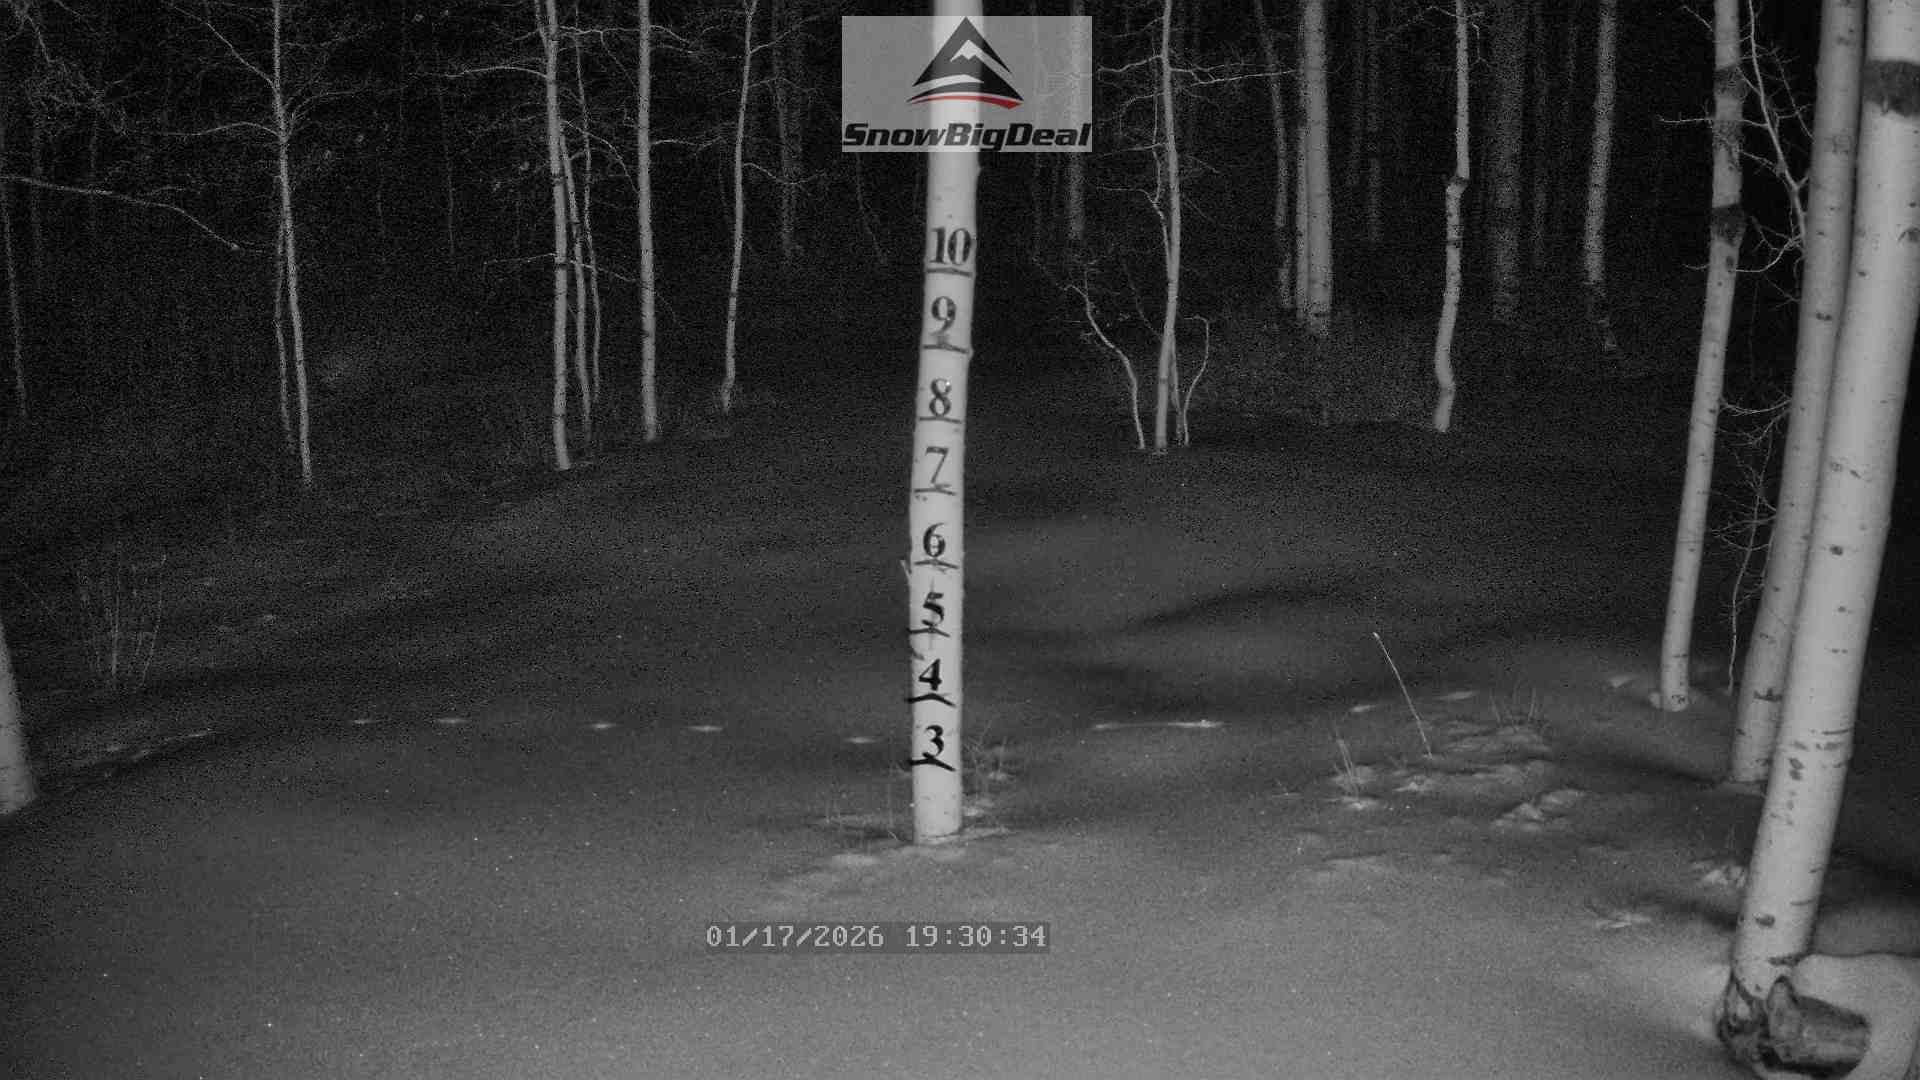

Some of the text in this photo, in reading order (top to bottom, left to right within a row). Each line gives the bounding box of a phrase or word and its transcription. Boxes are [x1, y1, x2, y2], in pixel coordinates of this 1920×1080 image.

[930, 226, 972, 265] 10
[930, 296, 957, 336] 9
[929, 378, 952, 418] 8
[925, 446, 949, 484] 7
[923, 522, 947, 558] 6
[922, 592, 944, 627] 5
[918, 658, 943, 691] 4
[922, 725, 945, 759] 3
